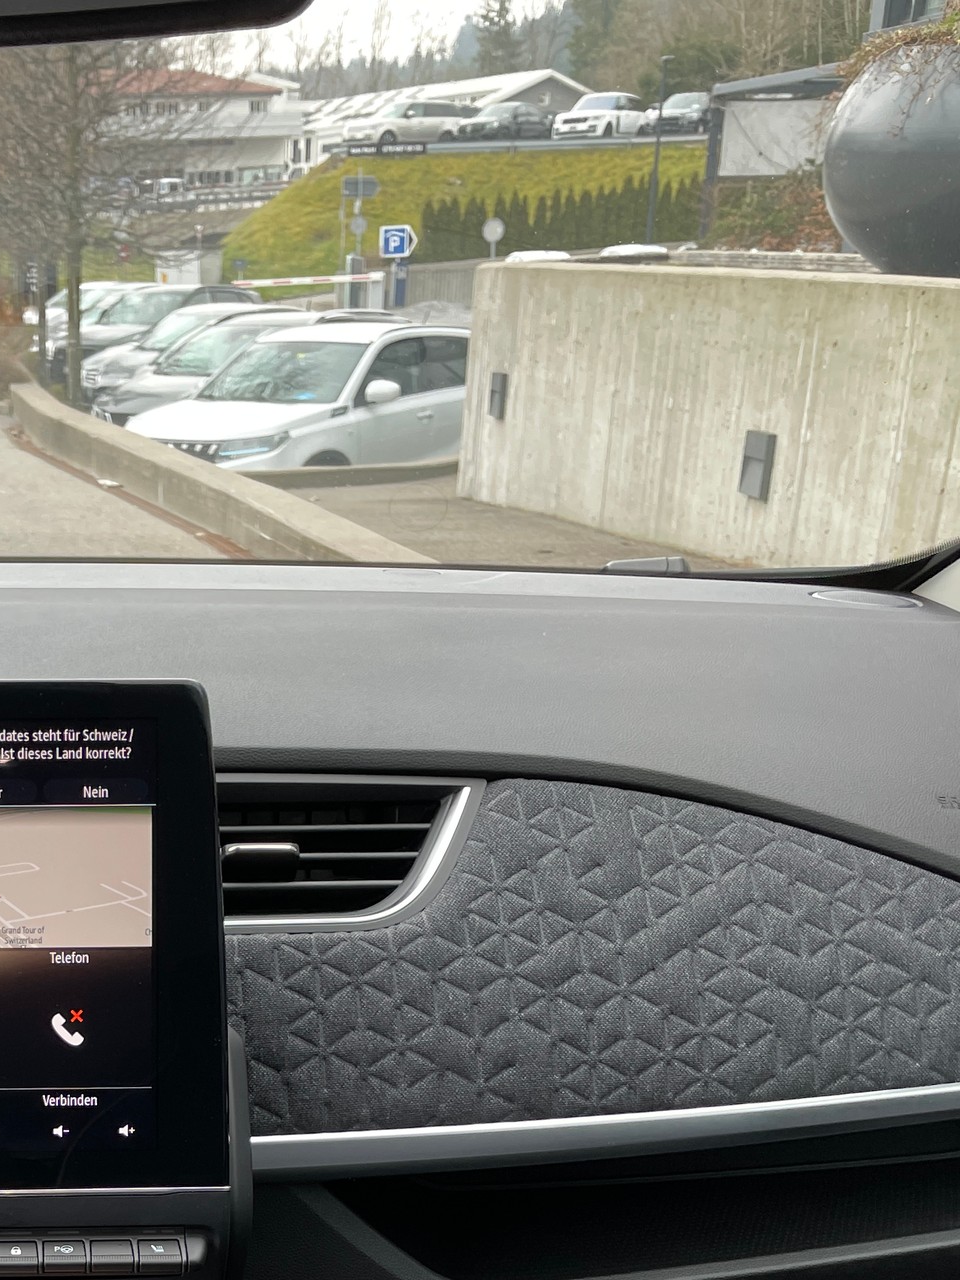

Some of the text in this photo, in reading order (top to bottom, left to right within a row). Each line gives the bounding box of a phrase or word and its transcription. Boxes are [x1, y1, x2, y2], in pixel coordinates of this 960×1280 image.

[388, 236, 400, 252] P
[32, 729, 62, 742] steht
[63, 728, 81, 742] für
[83, 728, 127, 742] Schweiz
[0, 747, 15, 760] Ist
[18, 747, 53, 760] dieses
[55, 746, 83, 760] Land
[85, 746, 132, 760] korrekt?
[83, 785, 109, 798] Nein
[1, 926, 45, 934] Grand Tour of
[4, 936, 43, 944] Switzerland
[49, 951, 90, 964] Telefon
[42, 1093, 98, 1107] Verbinden
